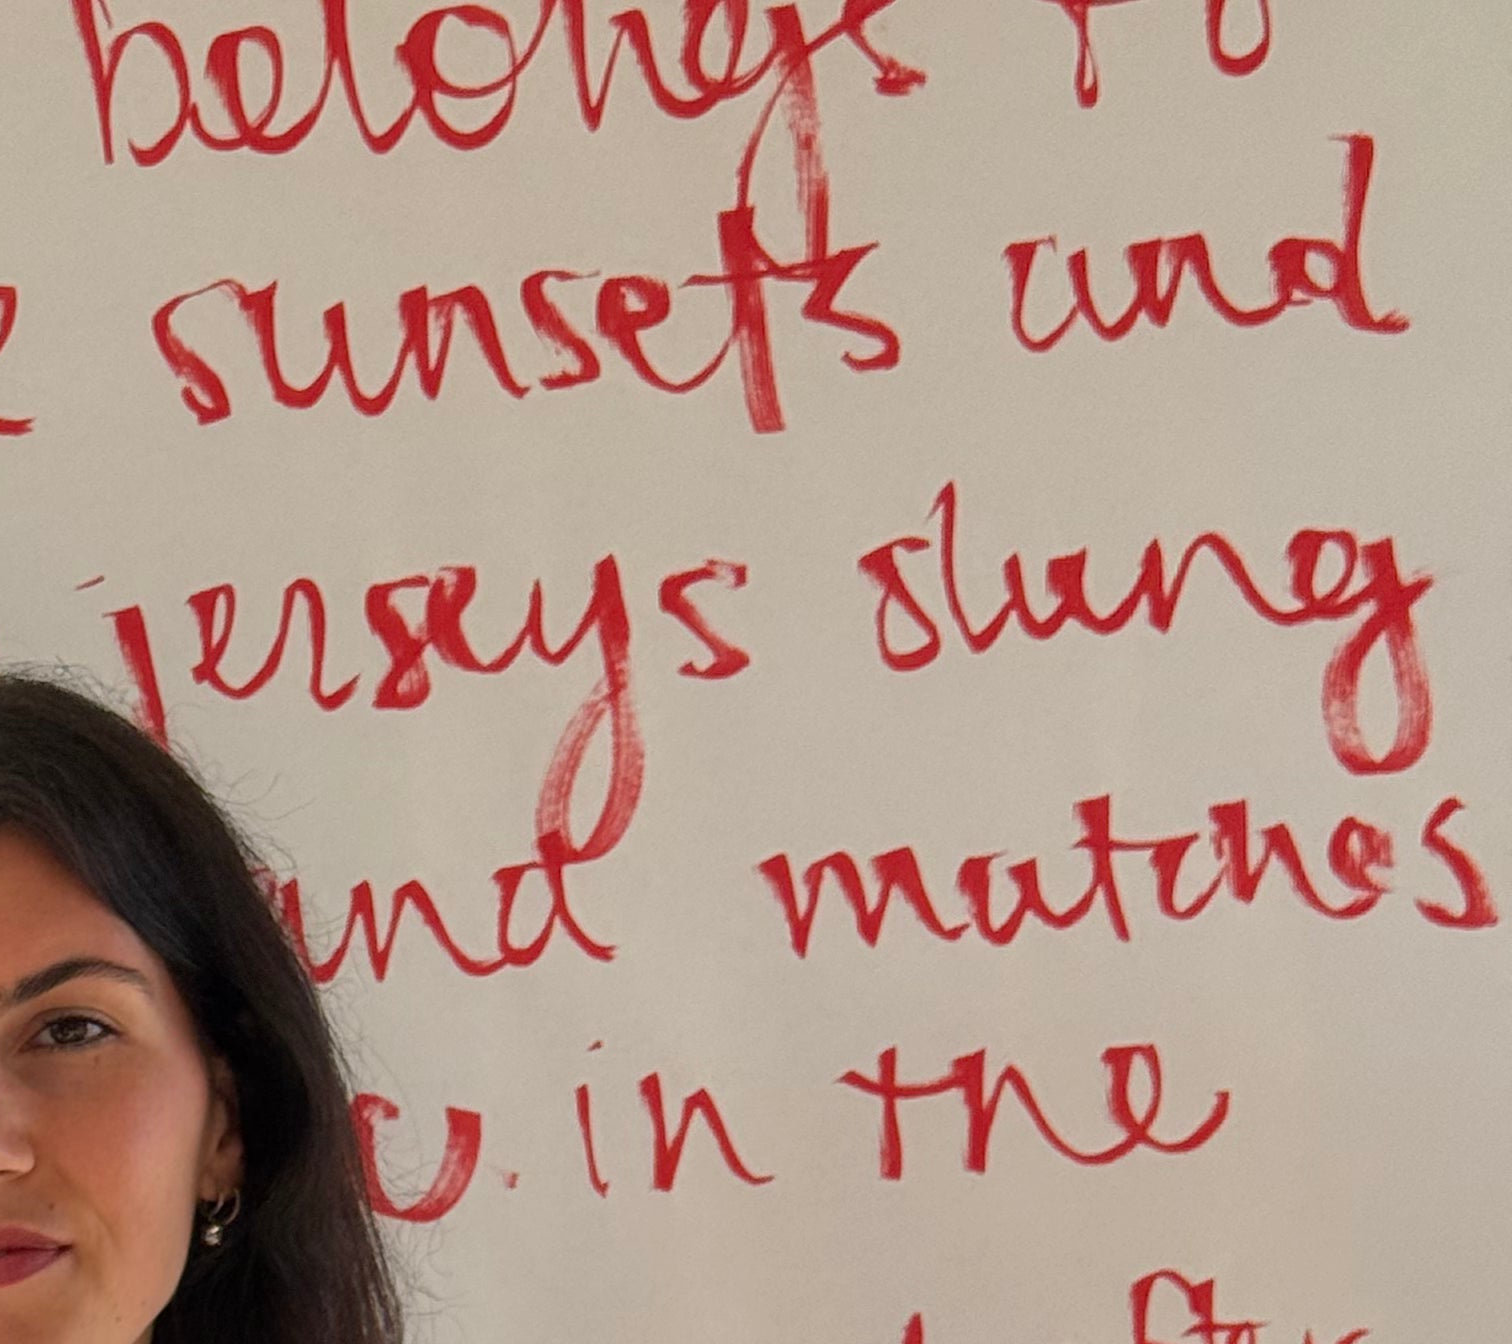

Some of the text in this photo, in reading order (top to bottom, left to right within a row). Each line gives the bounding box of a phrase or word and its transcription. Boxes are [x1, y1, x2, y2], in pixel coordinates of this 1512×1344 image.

[153, 207, 900, 432] sunsets
[1002, 135, 1410, 352] and
[858, 481, 1436, 776] slung
[758, 795, 1498, 958] matches
[576, 1042, 773, 1195] in
[838, 1044, 1230, 1180] the
